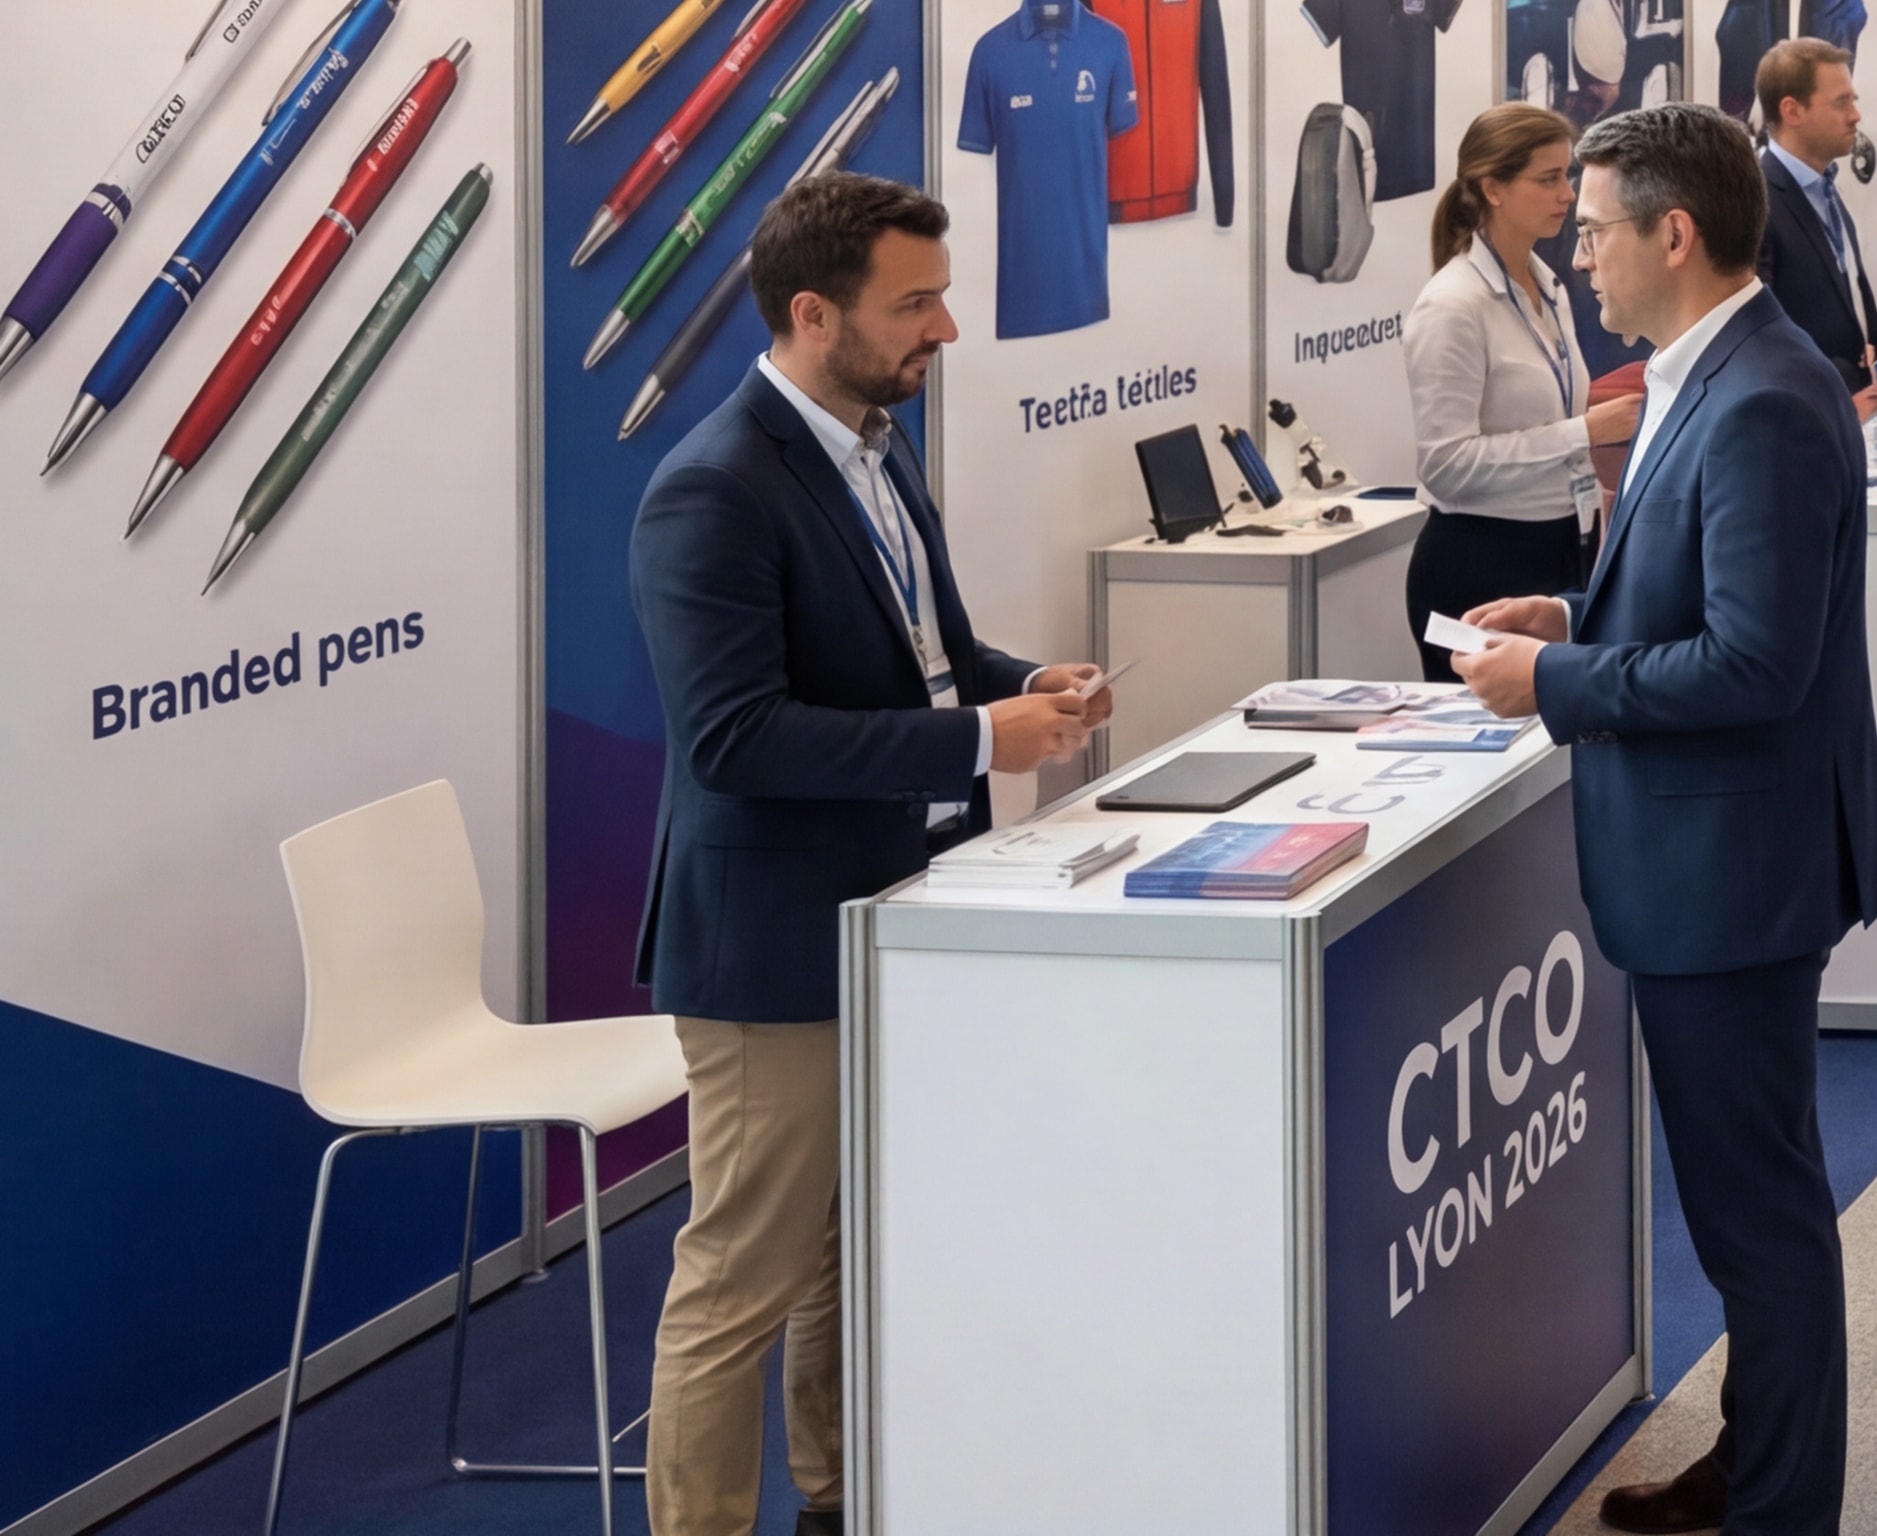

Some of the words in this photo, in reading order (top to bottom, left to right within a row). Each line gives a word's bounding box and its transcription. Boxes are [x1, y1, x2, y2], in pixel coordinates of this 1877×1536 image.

[92, 632, 301, 740] Branded
[318, 611, 425, 687] pens
[1387, 930, 1585, 1193] CTCO
[1388, 1154, 1493, 1319] LYON
[1504, 1071, 1588, 1210] 2026
